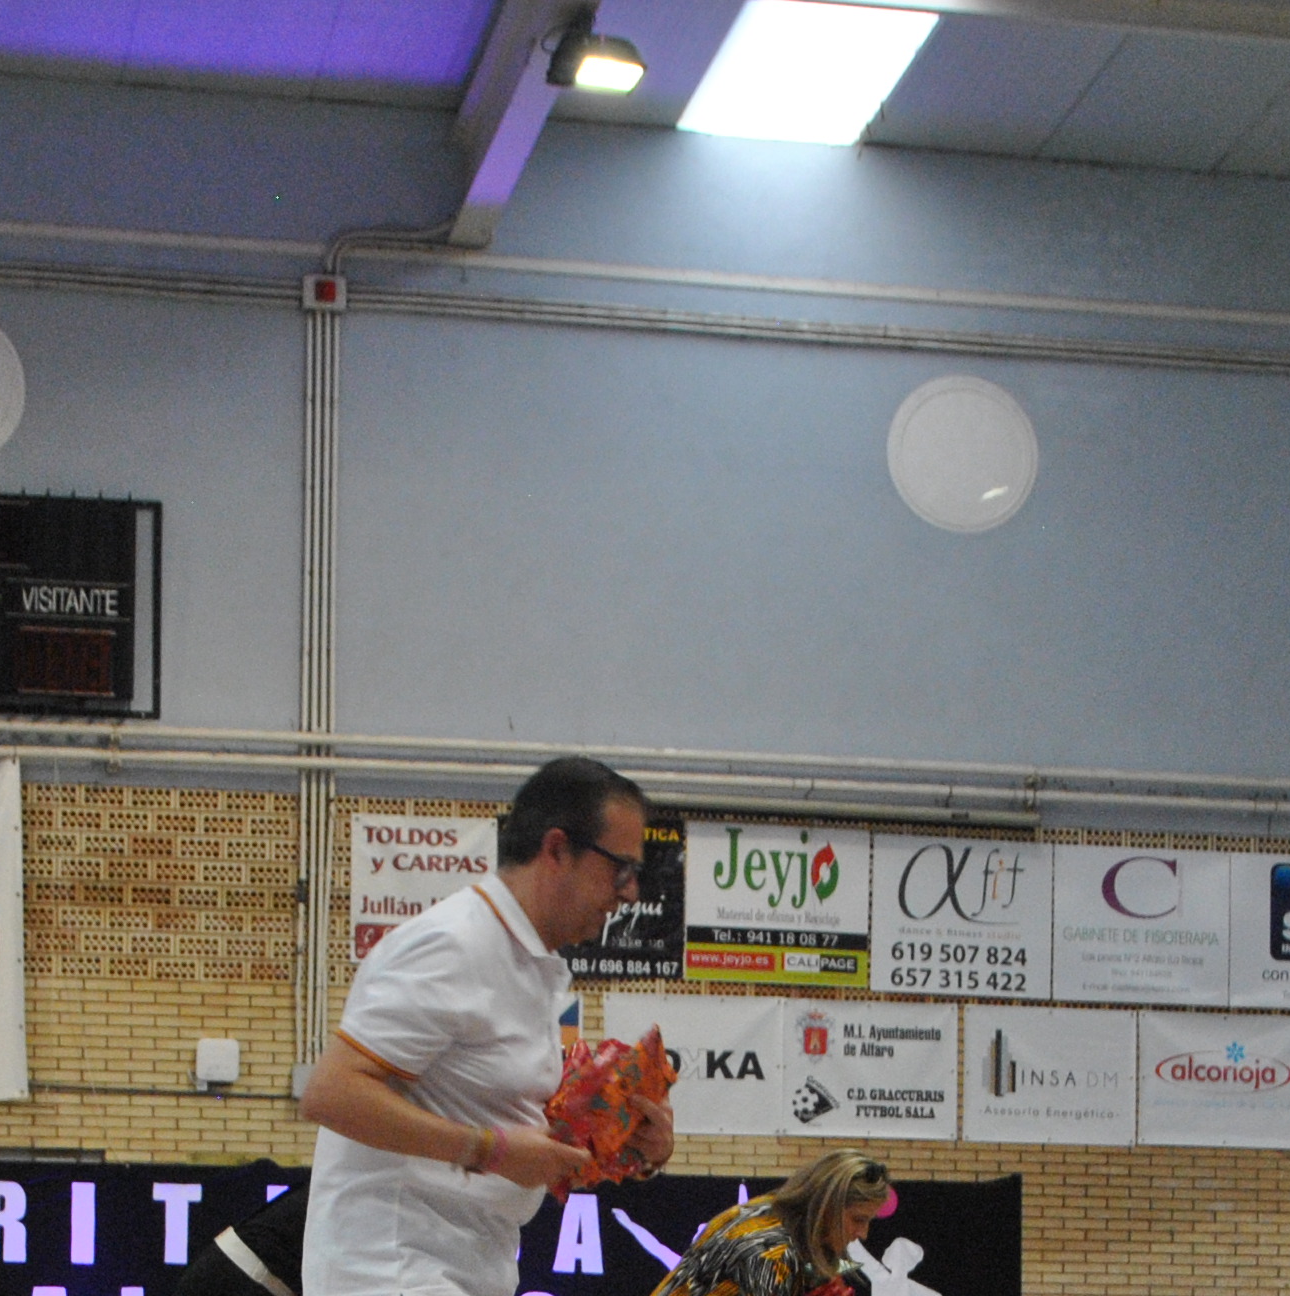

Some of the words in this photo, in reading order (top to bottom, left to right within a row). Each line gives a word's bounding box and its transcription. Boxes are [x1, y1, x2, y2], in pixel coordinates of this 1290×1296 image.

[22, 586, 118, 616] VISITANTE
[364, 825, 457, 847] TOLDOS
[370, 856, 385, 874] y
[392, 853, 488, 874] CARPAS
[360, 895, 422, 917] Julián
[747, 931, 772, 944] 941
[779, 932, 795, 945] 18
[691, 952, 770, 967] www.jeyjo.es
[891, 941, 933, 961] 619
[940, 944, 980, 964] 507
[986, 946, 1027, 966] 824
[655, 961, 678, 975] 167
[1262, 968, 1290, 981] con
[890, 967, 932, 987] 657
[939, 969, 979, 990] 315
[986, 972, 1026, 992] 422
[869, 1026, 942, 1041] Ayuntamiento
[843, 1042, 857, 1057] de
[860, 1043, 894, 1058] Alfaro
[1020, 1069, 1076, 1087] INSA
[1171, 1055, 1277, 1090] alcorioja
[870, 1088, 945, 1103] GRACCURRIS
[906, 1106, 935, 1120] SALA
